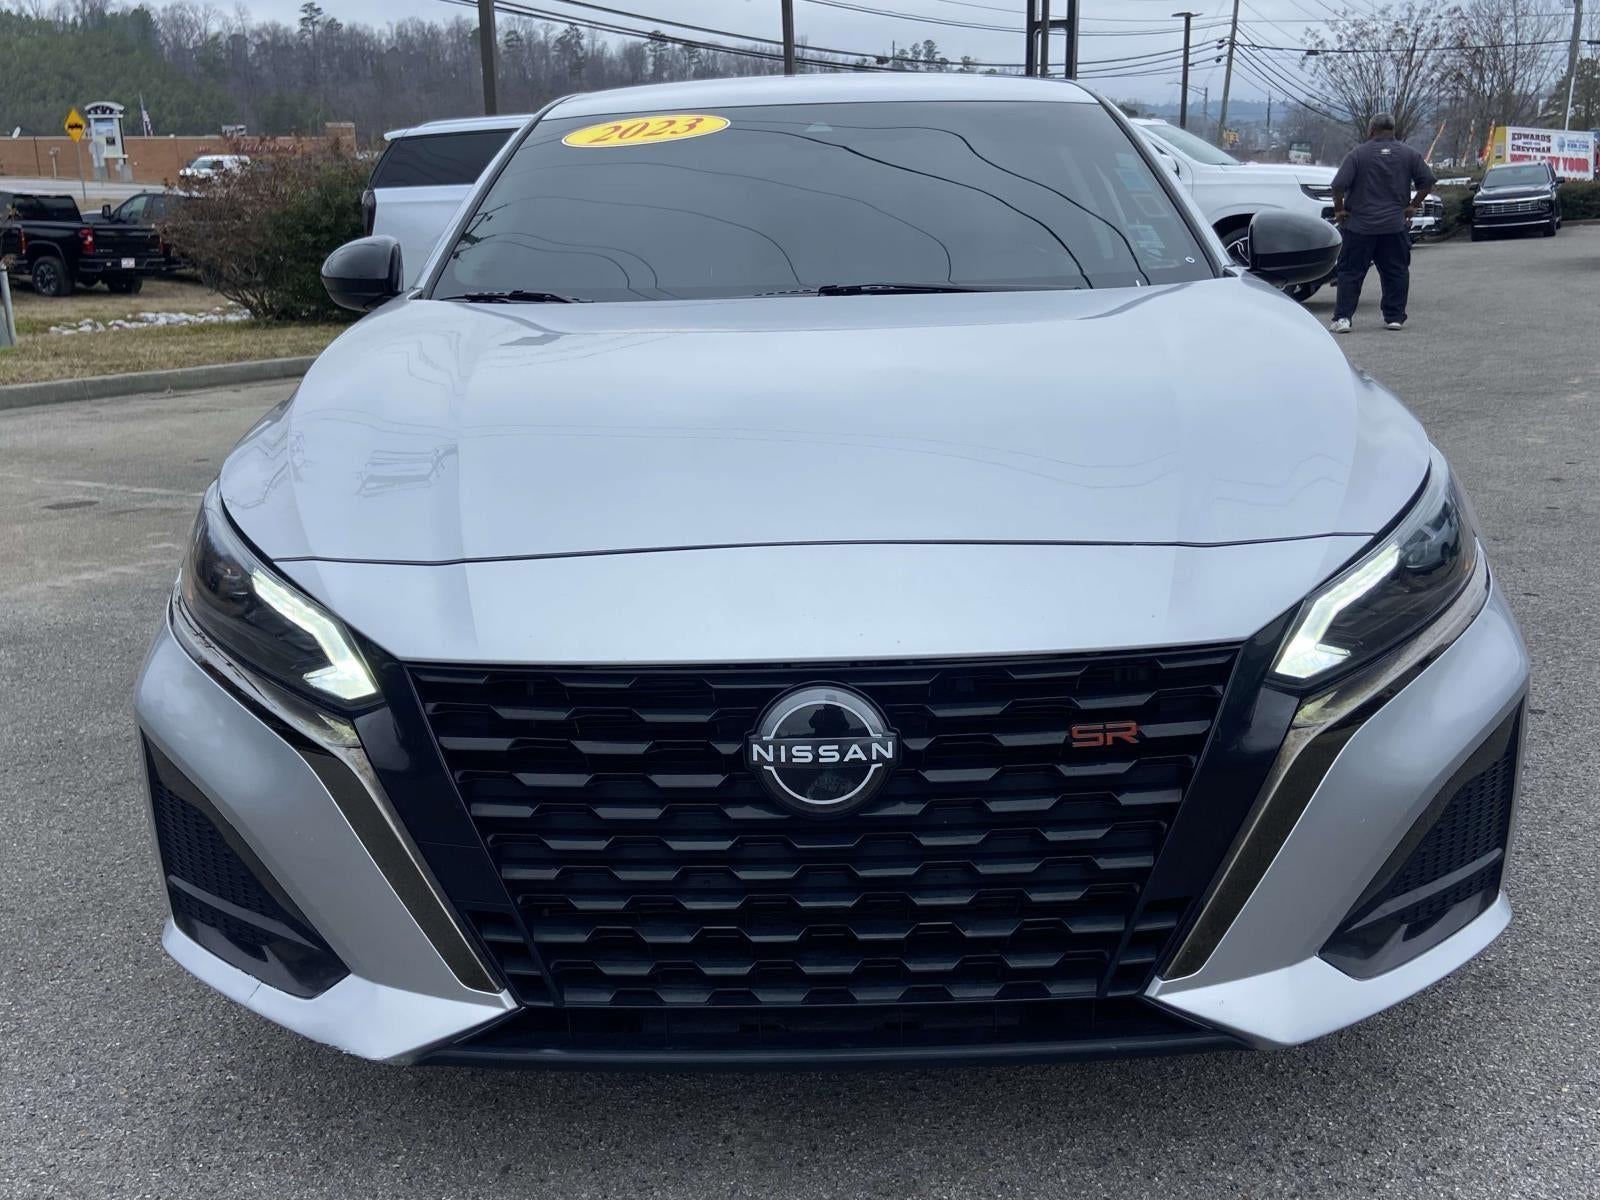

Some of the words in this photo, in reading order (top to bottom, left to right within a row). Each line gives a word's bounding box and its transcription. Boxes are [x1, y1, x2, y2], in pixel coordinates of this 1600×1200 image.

[588, 117, 704, 144] 2023
[1511, 132, 1551, 143] EDWARDS
[1511, 144, 1551, 153] CHEVYMAN
[1562, 157, 1589, 172] YOUR
[1072, 721, 1138, 747] SR
[752, 741, 893, 763] NISSAN
